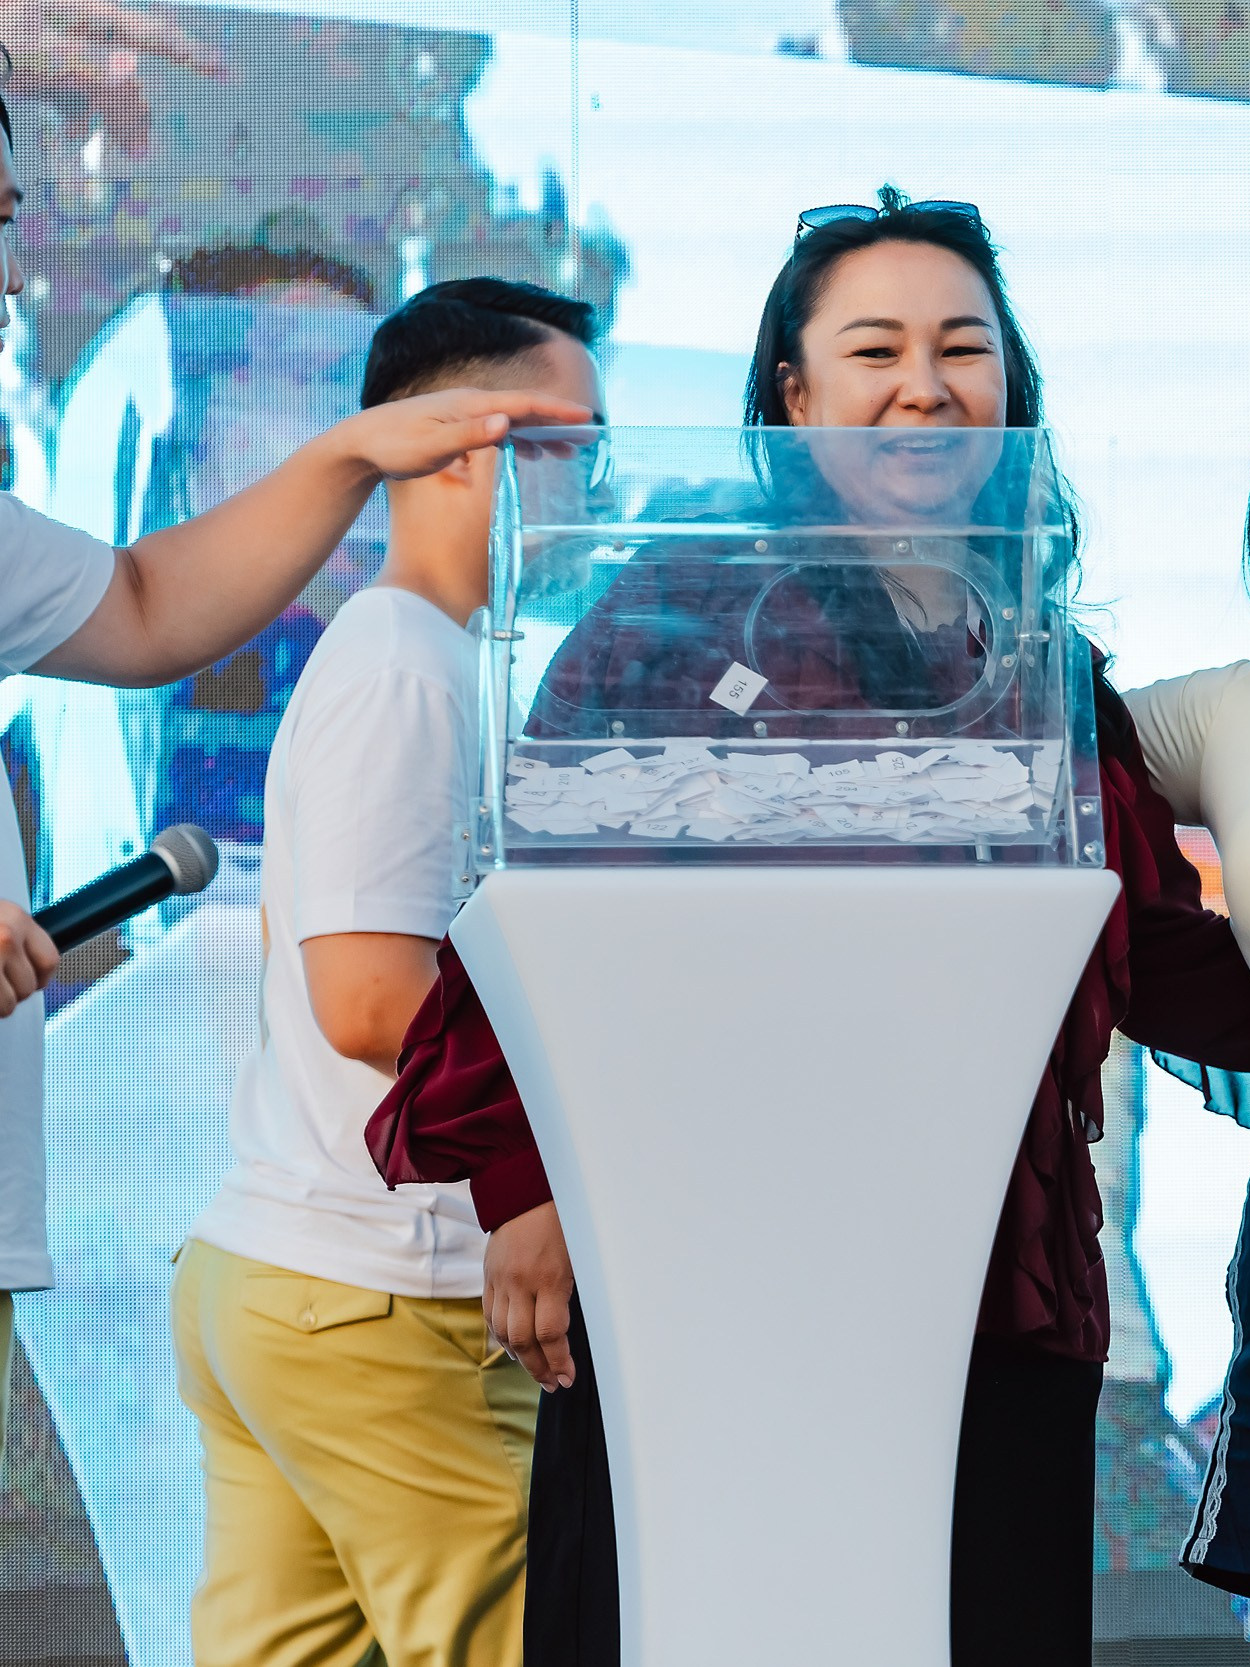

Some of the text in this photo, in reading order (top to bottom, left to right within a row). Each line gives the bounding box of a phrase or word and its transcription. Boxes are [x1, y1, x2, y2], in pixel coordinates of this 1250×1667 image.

[729, 680, 748, 699] 155
[557, 773, 570, 786] 210
[646, 823, 668, 831] 122
